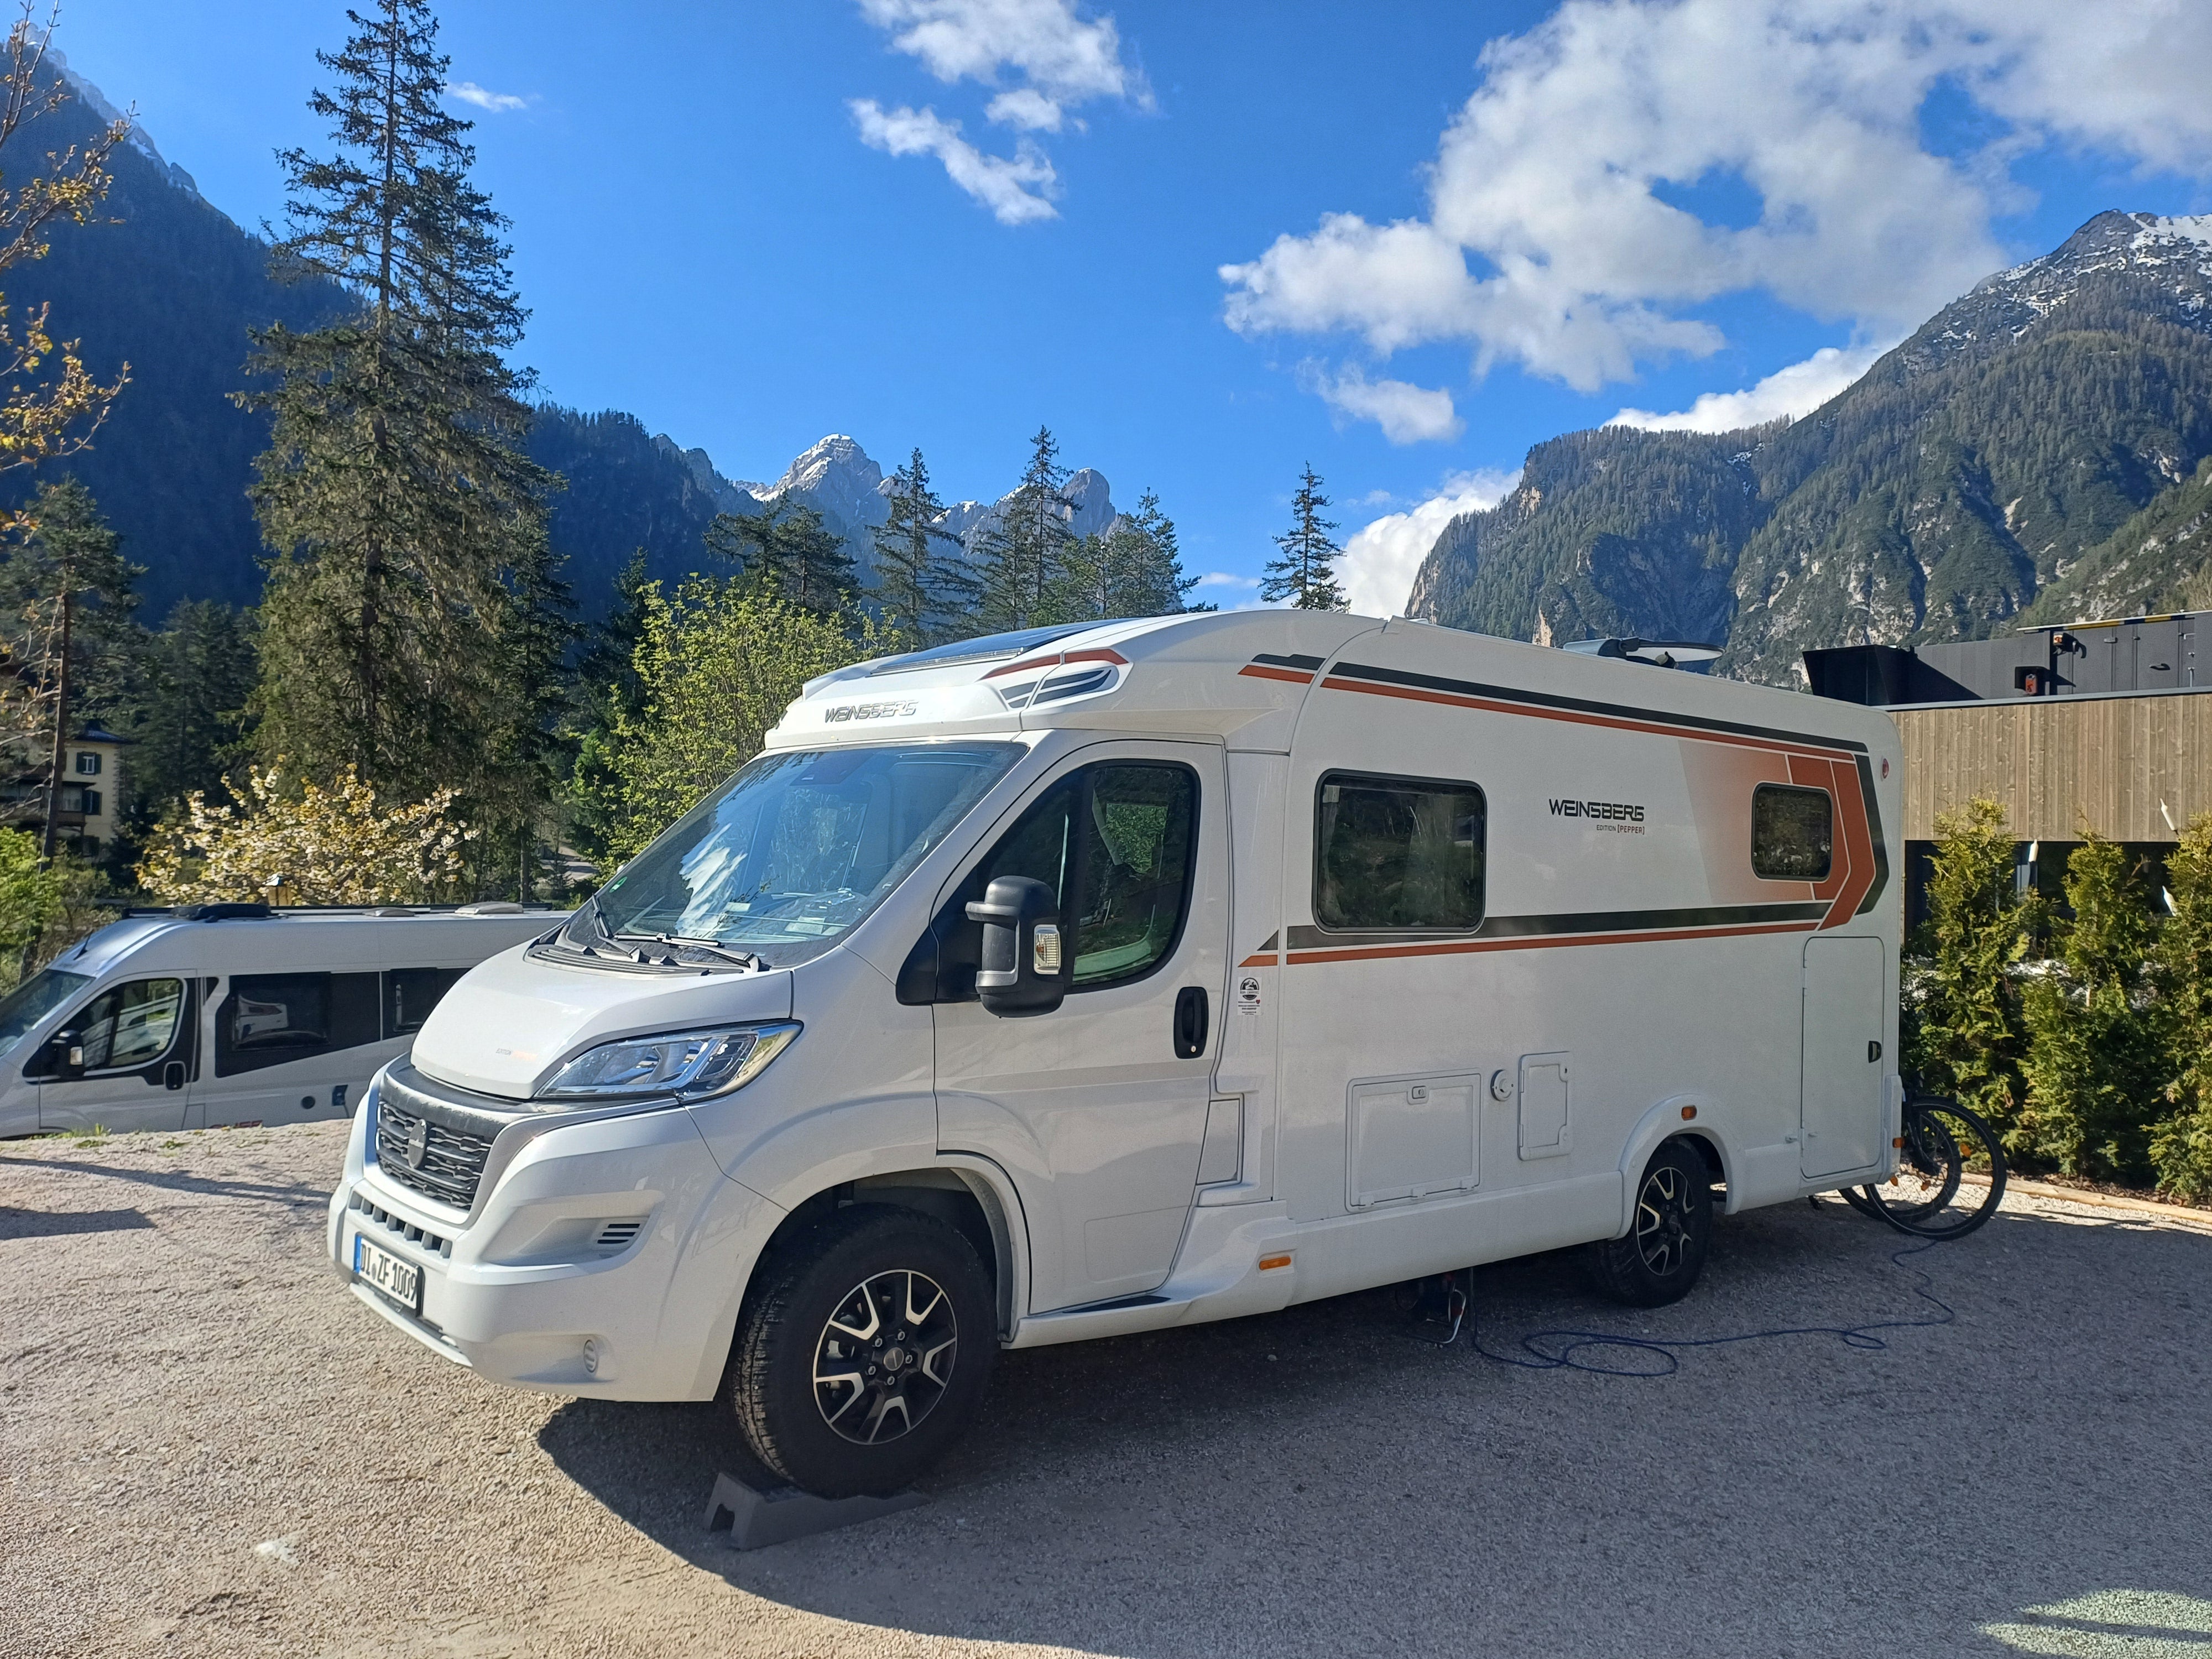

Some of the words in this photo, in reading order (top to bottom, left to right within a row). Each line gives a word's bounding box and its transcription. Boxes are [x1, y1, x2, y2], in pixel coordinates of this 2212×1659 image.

[825, 699, 919, 723] WEINSBERG
[1548, 799, 1645, 822] WEINSBERG
[378, 1253, 390, 1285] ZF
[392, 1263, 416, 1301] 1009
